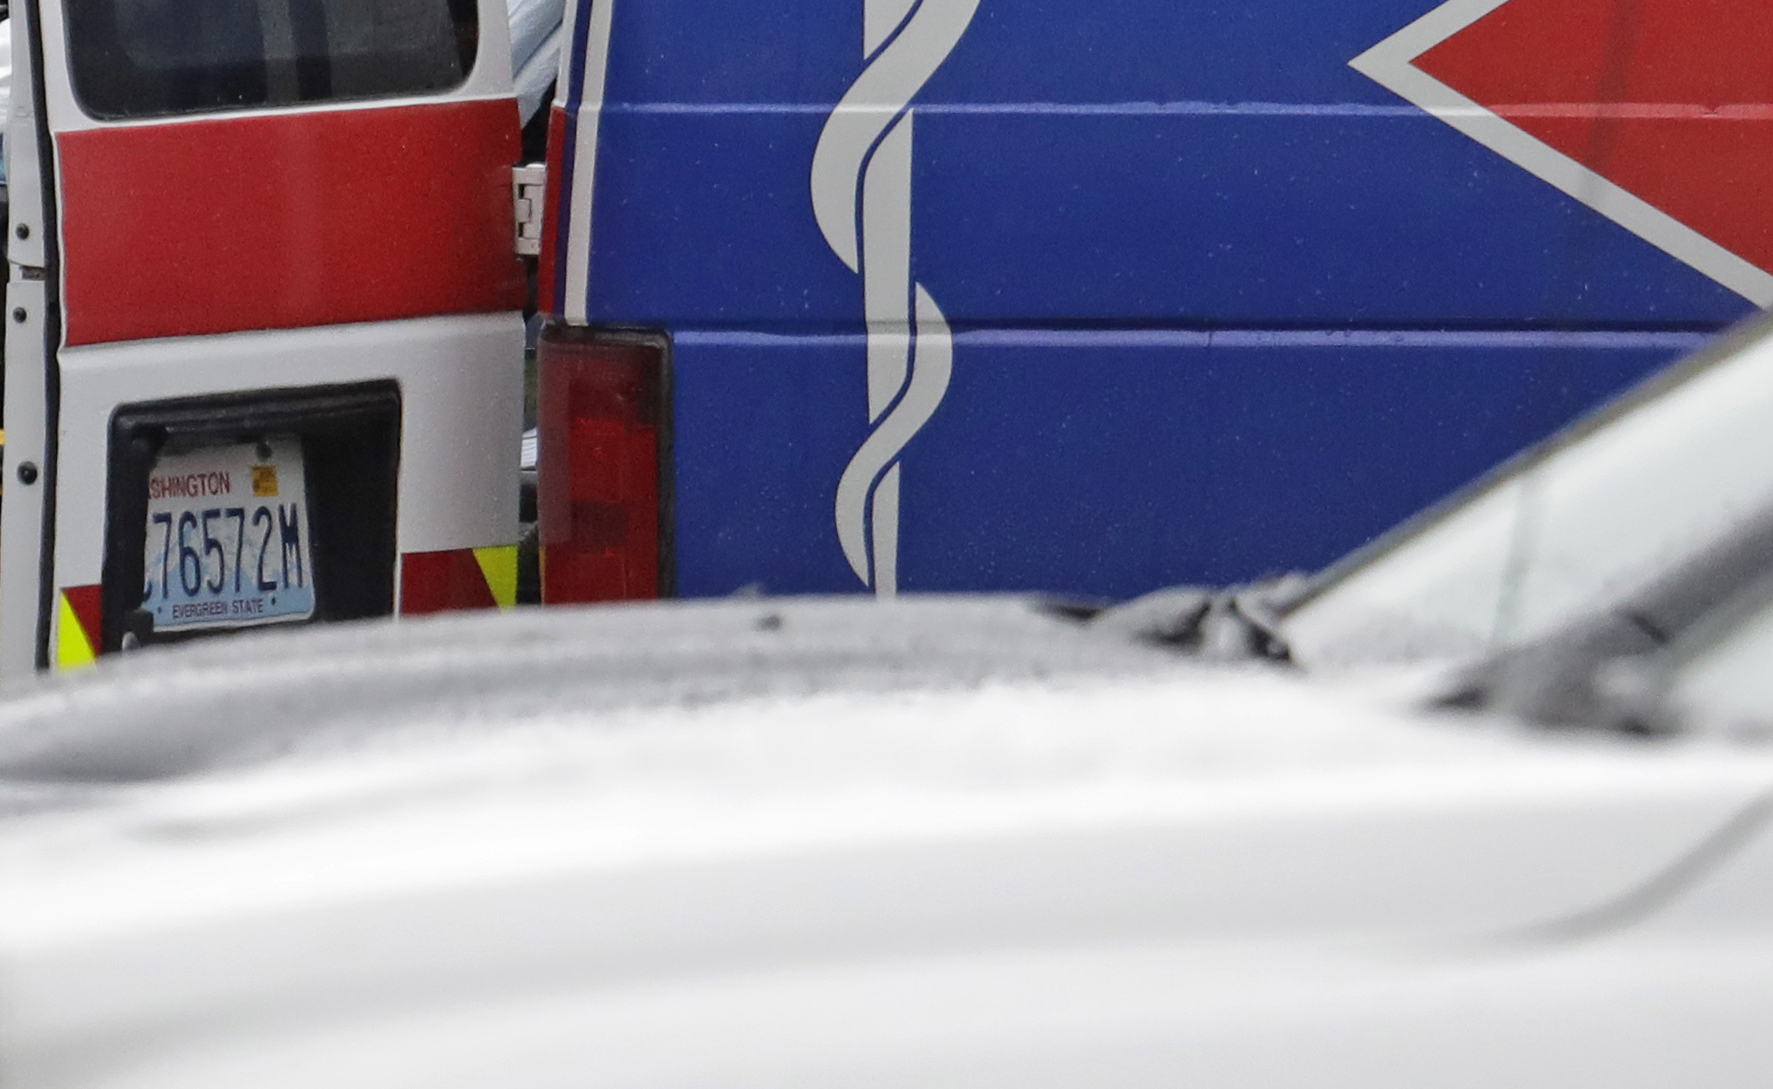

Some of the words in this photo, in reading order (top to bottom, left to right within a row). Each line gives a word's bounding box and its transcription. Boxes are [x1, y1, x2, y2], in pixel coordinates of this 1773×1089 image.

[149, 472, 230, 499] SHINGTON
[144, 503, 303, 601] 76572M
[172, 601, 227, 619] EVERGREEN
[232, 598, 264, 614] STATE
